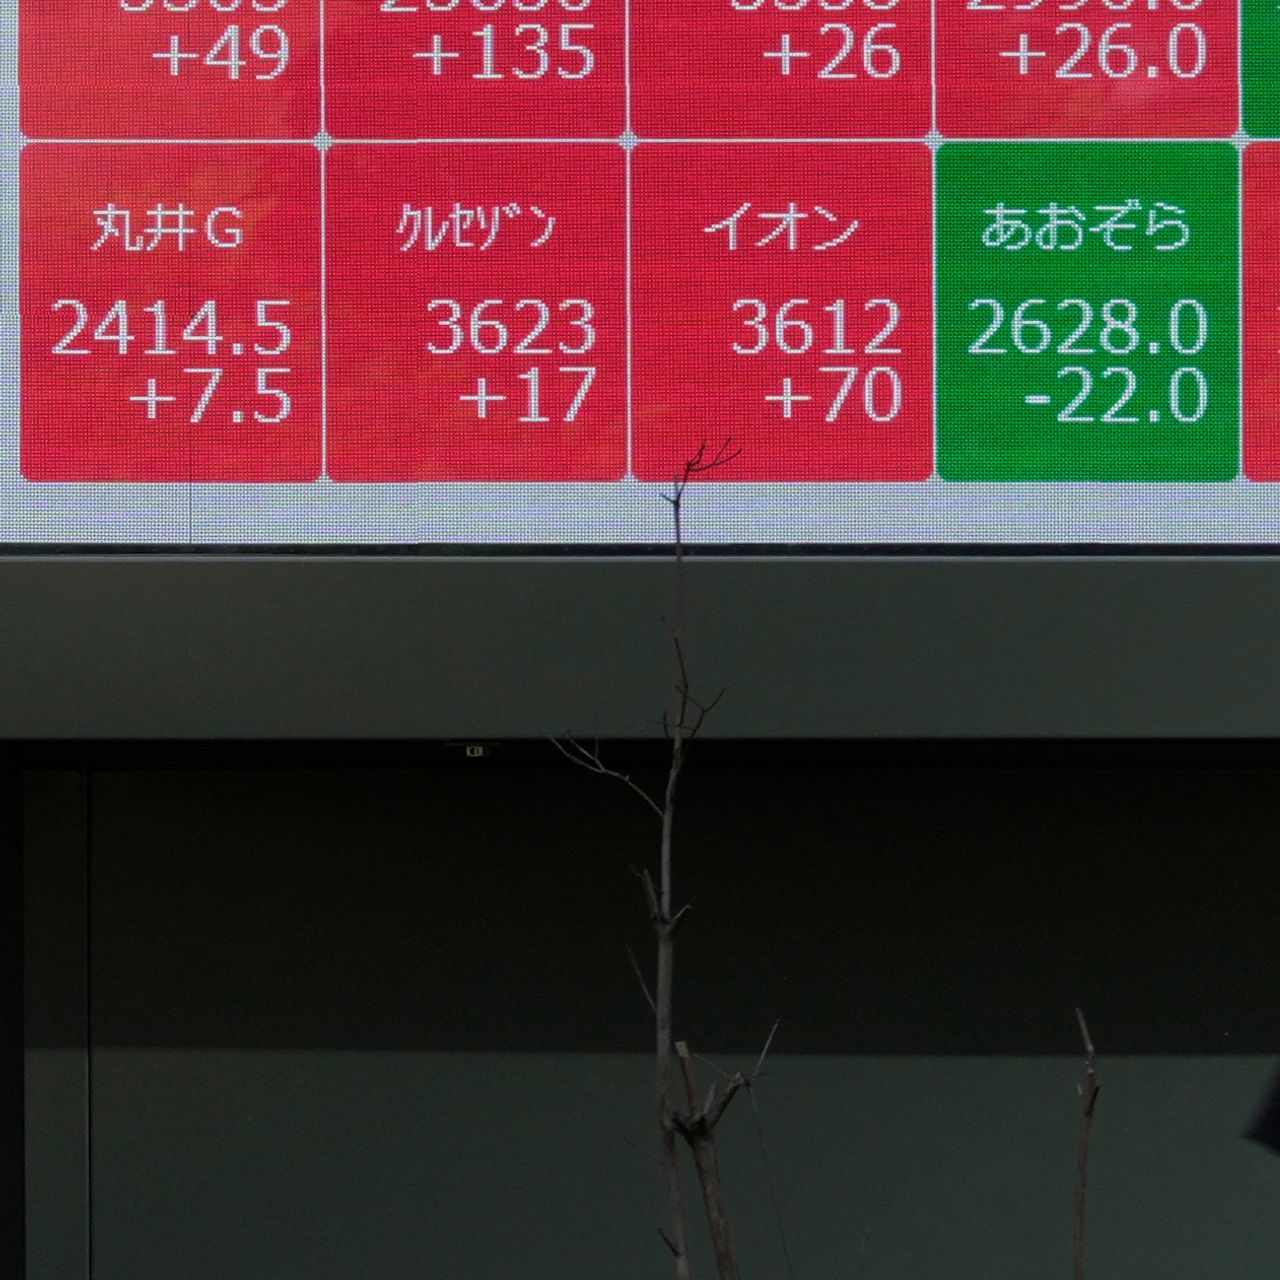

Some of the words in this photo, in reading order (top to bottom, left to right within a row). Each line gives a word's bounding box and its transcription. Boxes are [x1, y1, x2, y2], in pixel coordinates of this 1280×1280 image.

[153, 24, 290, 81] +49
[414, 23, 595, 80] +135
[764, 22, 901, 80] +26
[1001, 22, 1207, 80] +26.0
[704, 202, 859, 251] イオン
[982, 199, 1190, 252] あおぞら
[52, 299, 291, 356] 2414.5
[427, 298, 596, 355] 3623
[732, 298, 901, 355] 3612
[969, 298, 1208, 355] 2628.0
[130, 367, 292, 424] +7.5
[460, 366, 597, 423] +17
[765, 366, 902, 423] +70
[1025, 366, 1208, 424] -22.0
